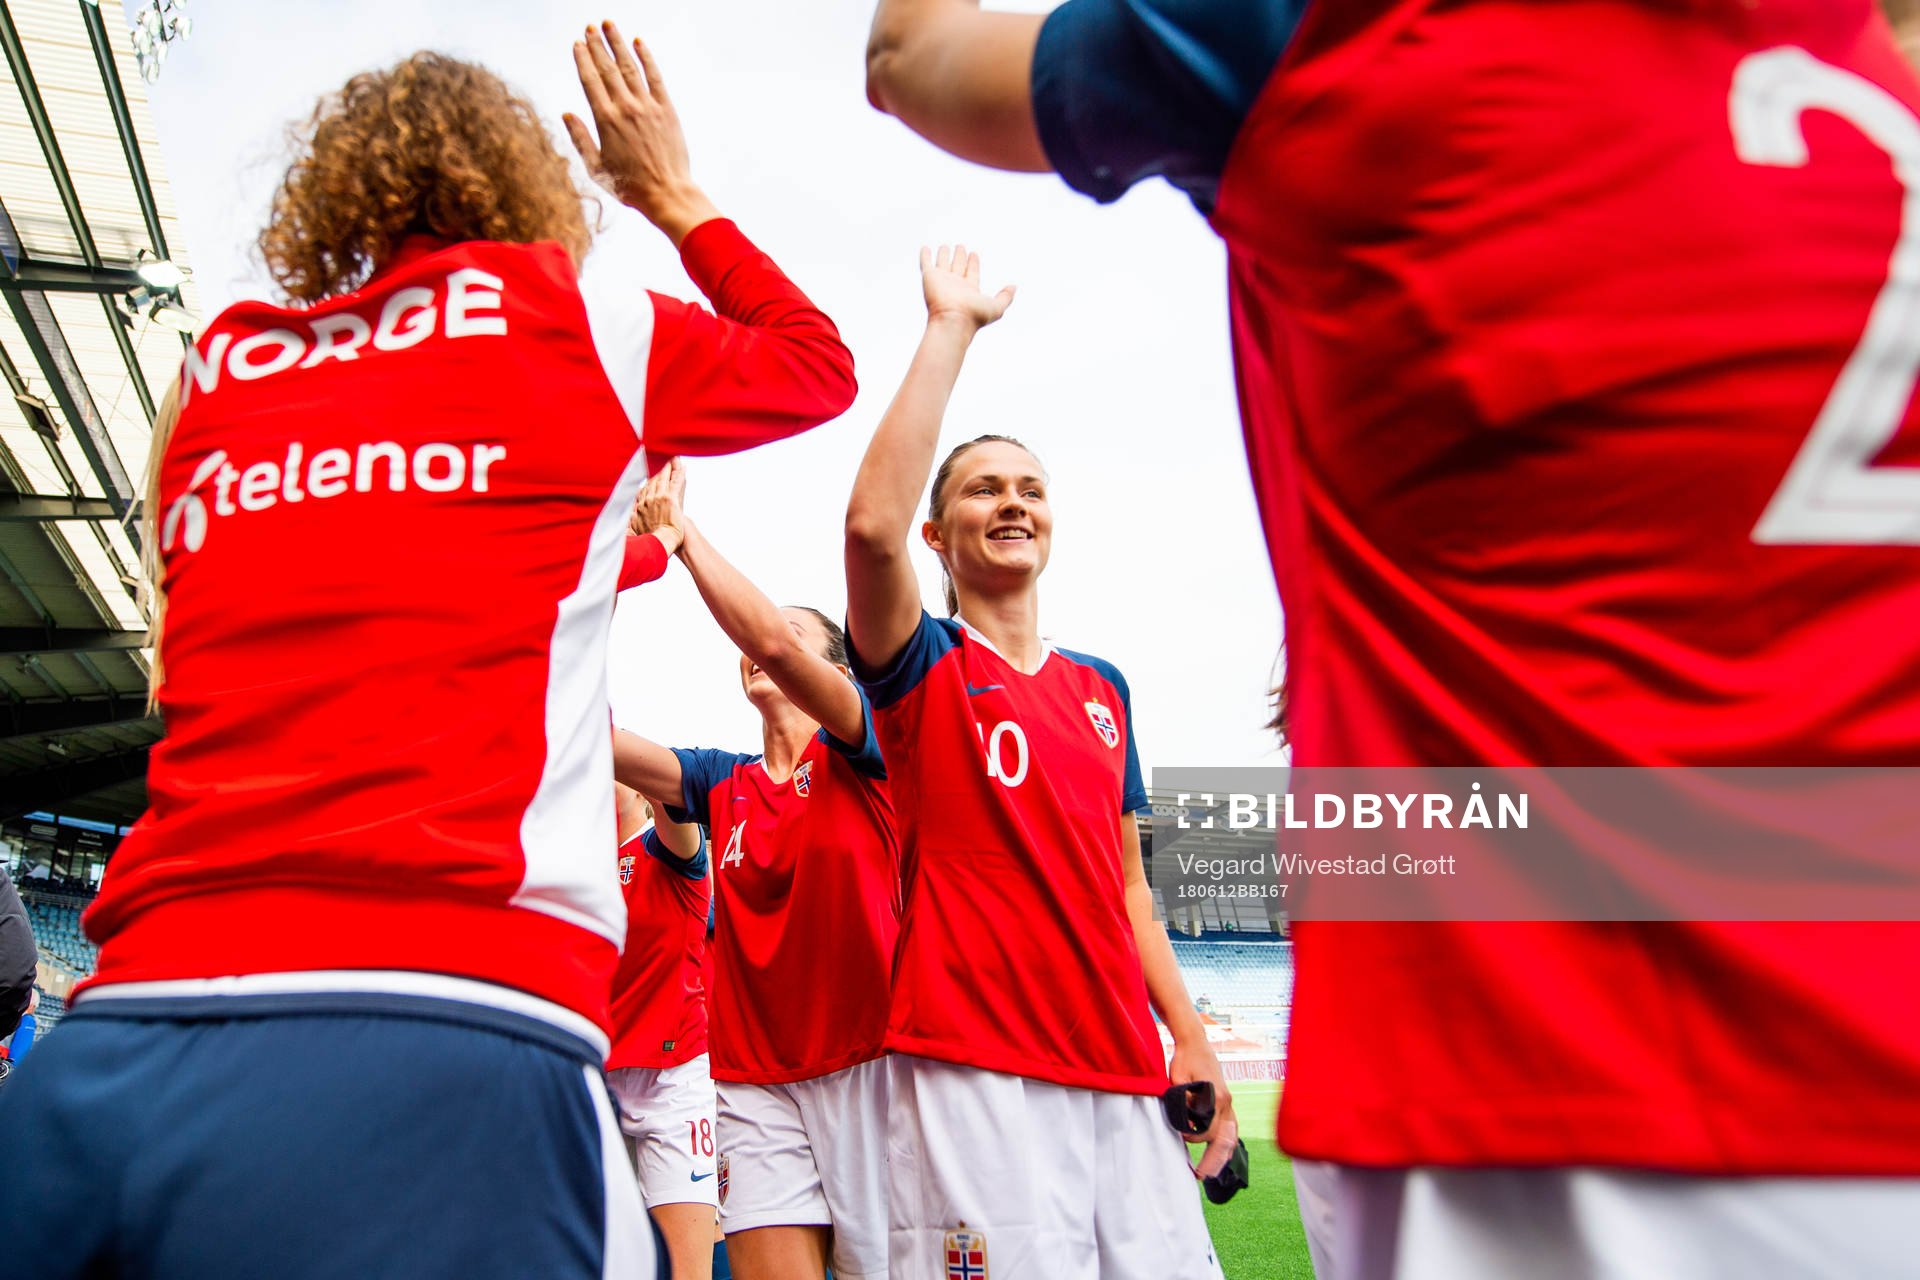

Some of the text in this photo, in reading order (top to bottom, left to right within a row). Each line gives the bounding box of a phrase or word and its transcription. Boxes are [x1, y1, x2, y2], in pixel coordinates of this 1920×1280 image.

[181, 268, 507, 409] NORGE
[1727, 45, 1920, 545] 2
[214, 442, 506, 516] telenor
[685, 1118, 714, 1157] 18
